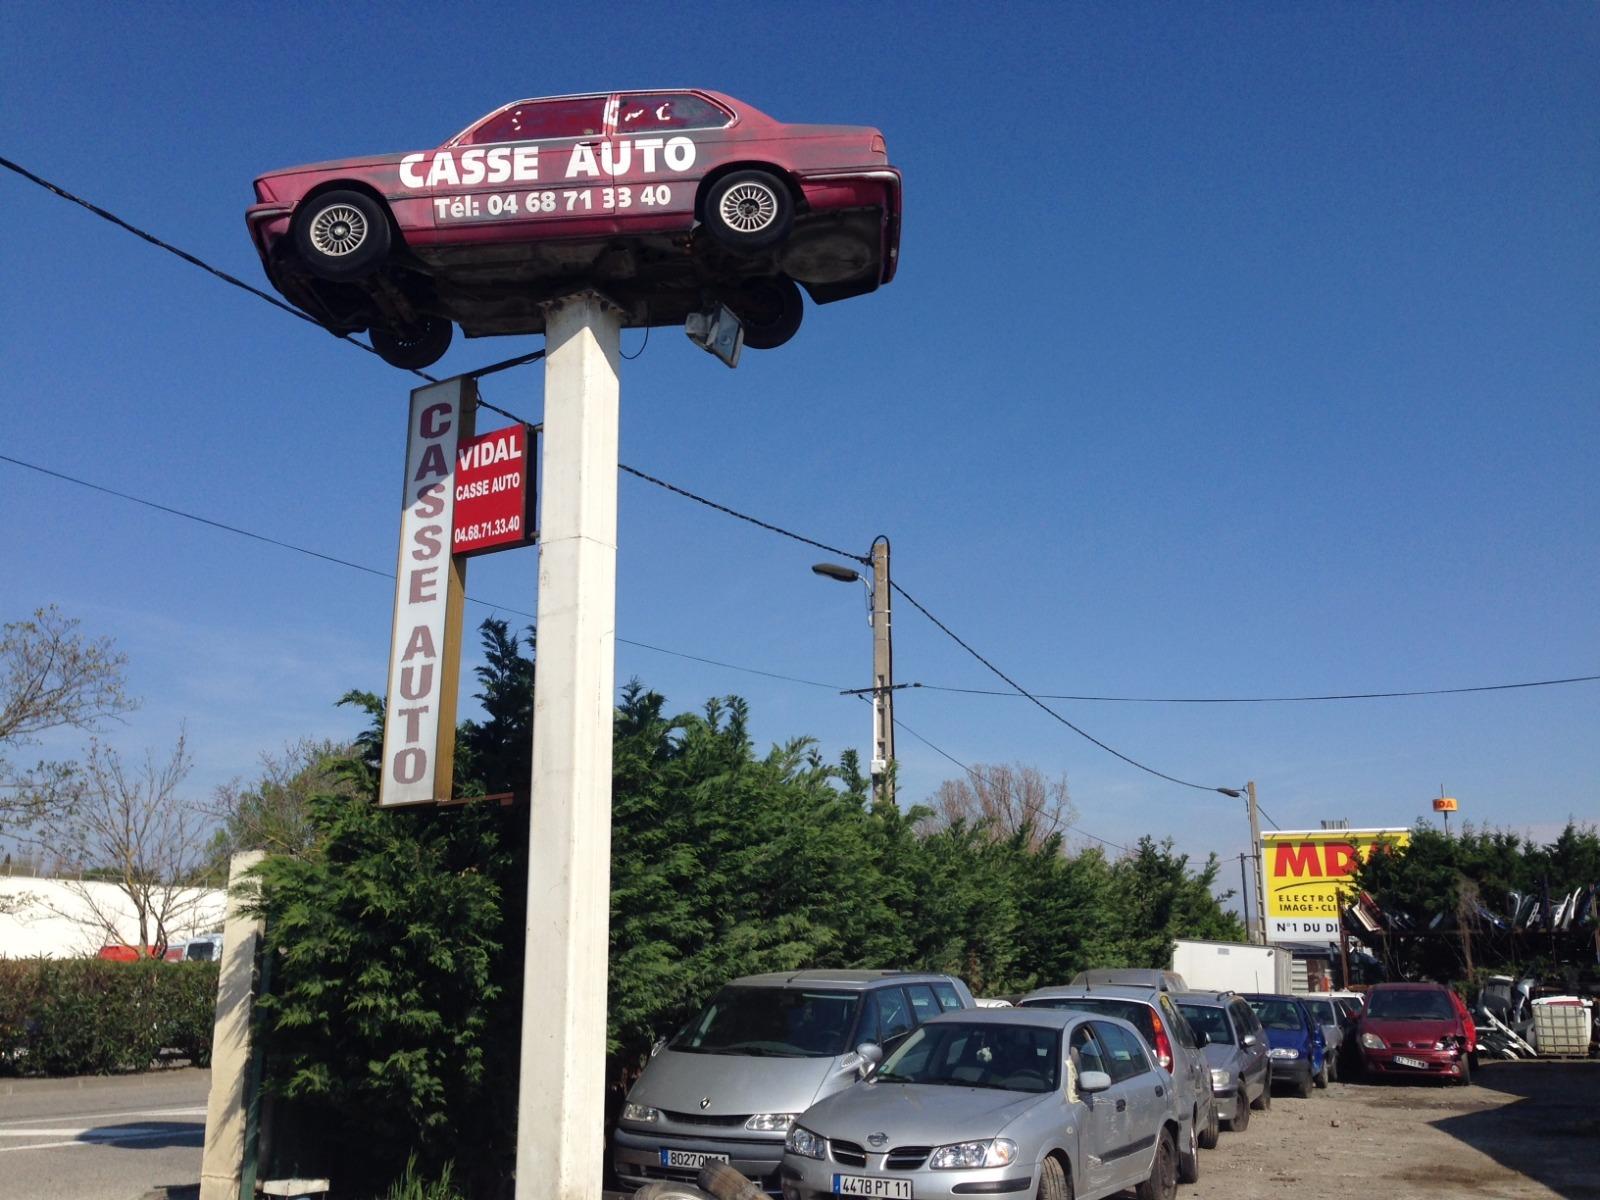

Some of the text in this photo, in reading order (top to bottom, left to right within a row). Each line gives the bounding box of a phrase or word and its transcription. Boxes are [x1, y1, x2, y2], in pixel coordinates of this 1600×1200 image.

[399, 136, 696, 188] CASSE AUTO
[434, 185, 671, 219] Tél: 04 68 71 33 40
[459, 435, 522, 472] VIDAL
[456, 472, 520, 502] CASSE AUTO
[454, 515, 520, 543] 04.68.71.33.40
[392, 402, 453, 785] CASSE AUTO
[1303, 923, 1320, 932] DU
[670, 1152, 697, 1167] 8027
[842, 1177, 908, 1197] 4478 PT 11
